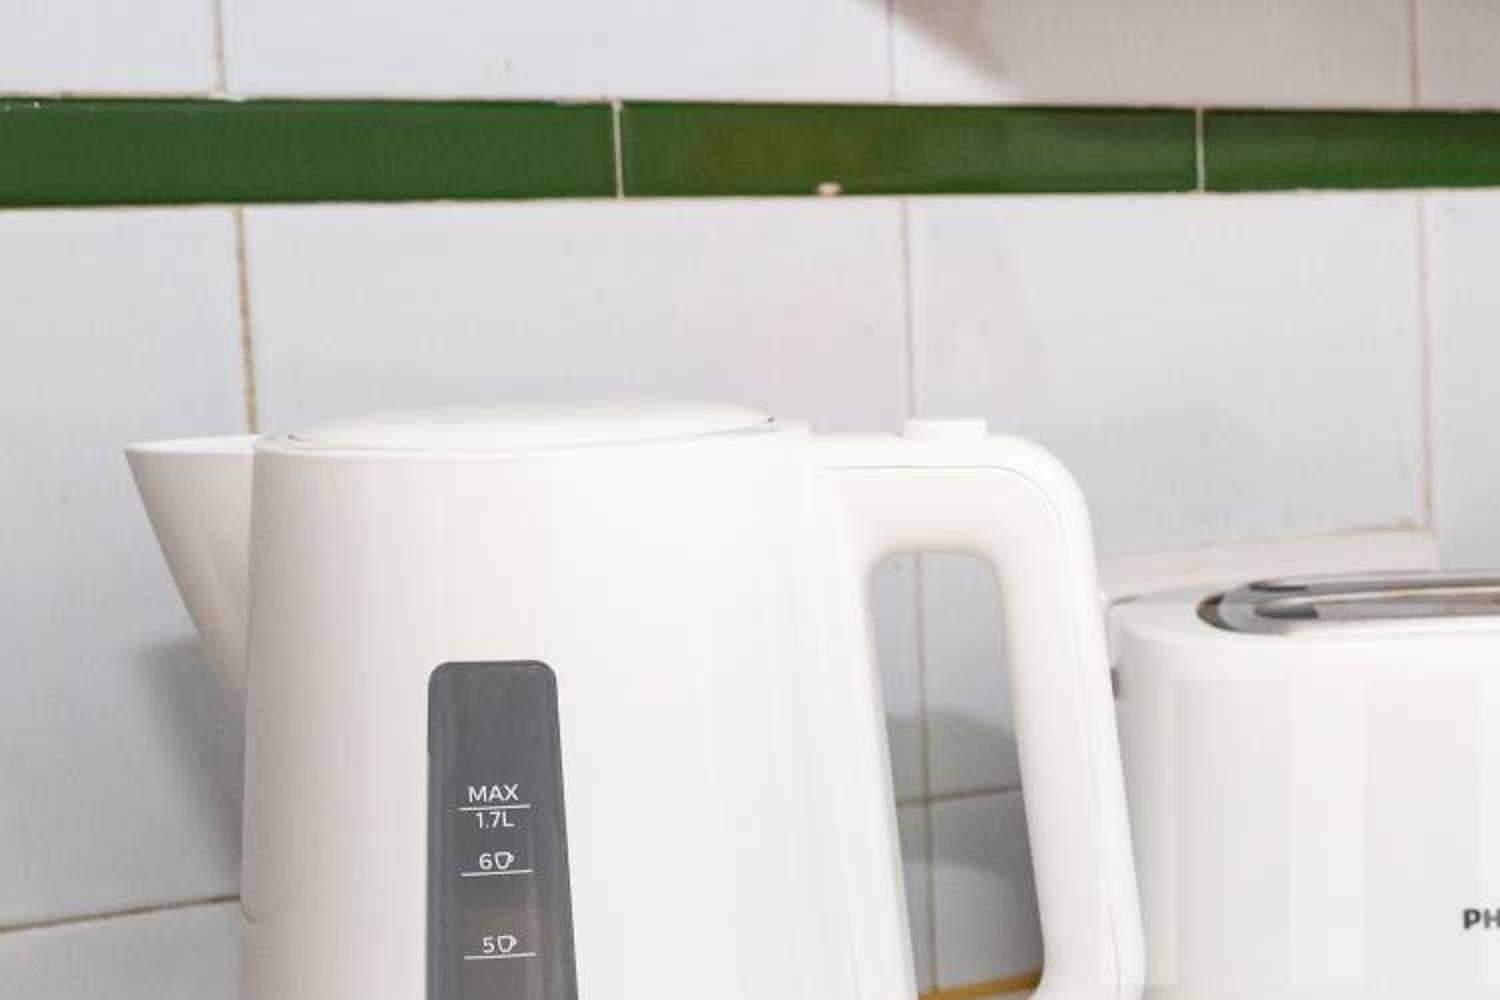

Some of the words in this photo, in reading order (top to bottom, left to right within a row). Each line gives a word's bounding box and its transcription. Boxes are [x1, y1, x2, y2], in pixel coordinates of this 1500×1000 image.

[468, 783, 519, 803] MAX
[475, 810, 515, 829] 1.7L
[479, 853, 493, 870] 6
[482, 936, 495, 954] 5
